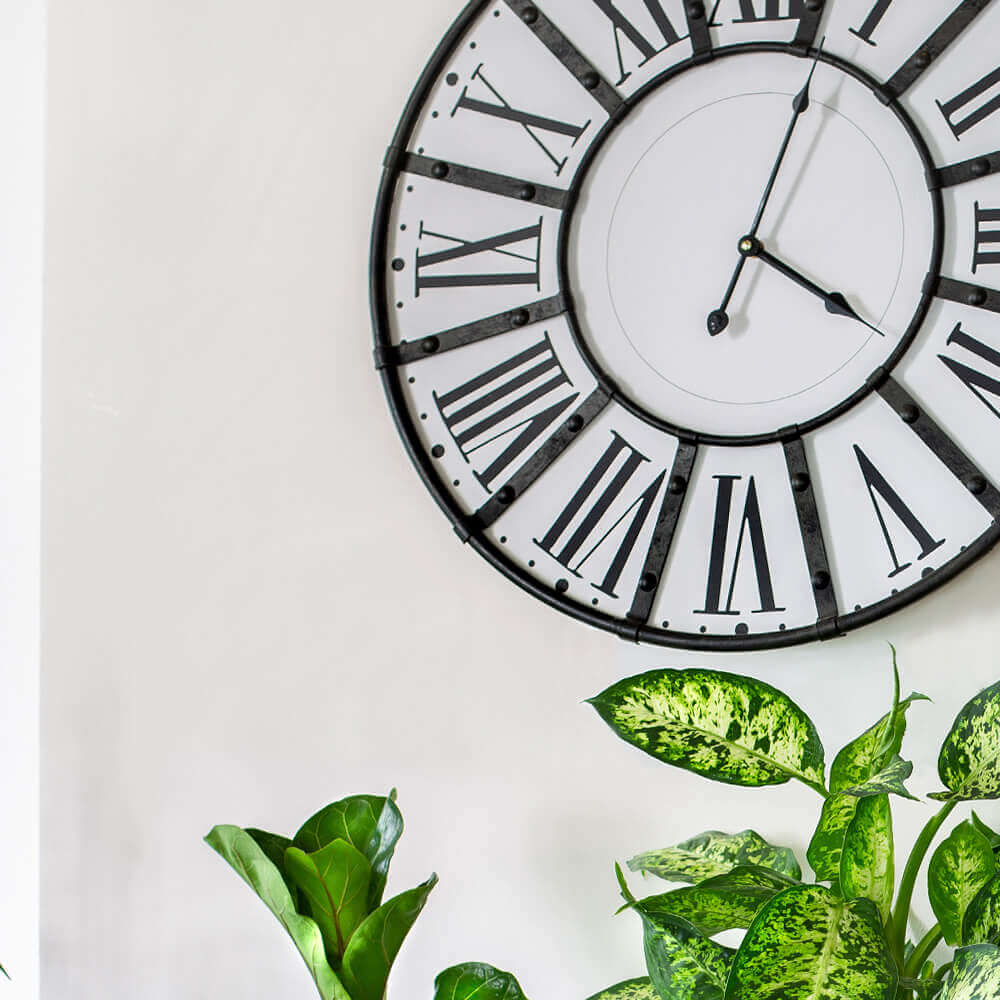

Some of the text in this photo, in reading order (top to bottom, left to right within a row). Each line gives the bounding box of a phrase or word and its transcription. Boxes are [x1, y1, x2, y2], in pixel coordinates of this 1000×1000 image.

[450, 63, 592, 177] X
[414, 215, 544, 298] IX
[431, 330, 581, 495] VIII
[532, 429, 667, 600] VII
[692, 474, 787, 616] VI
[852, 443, 946, 578] V
